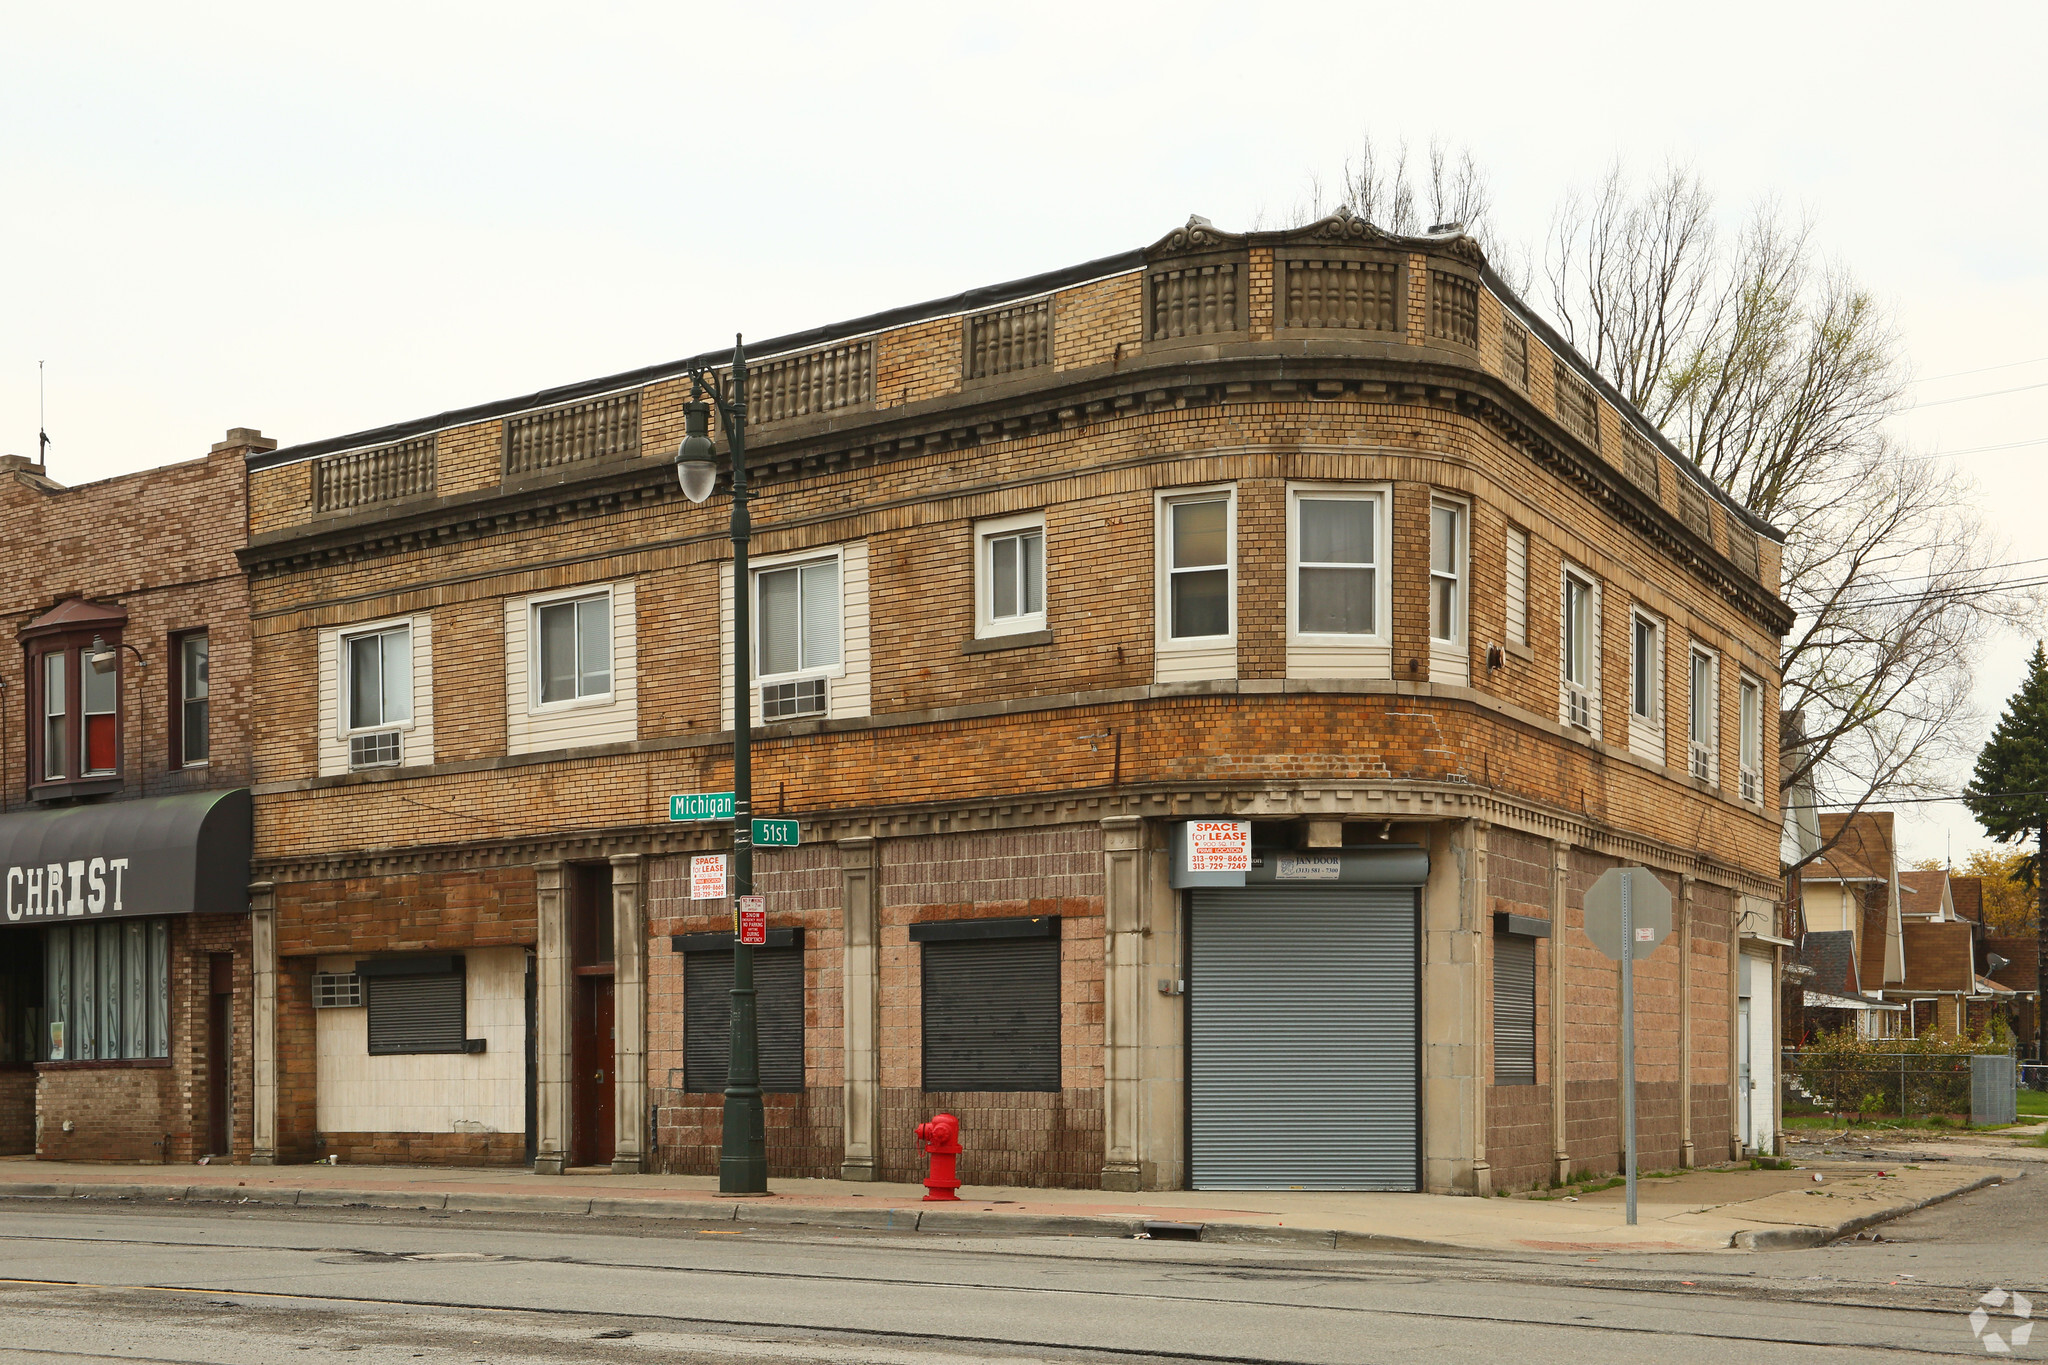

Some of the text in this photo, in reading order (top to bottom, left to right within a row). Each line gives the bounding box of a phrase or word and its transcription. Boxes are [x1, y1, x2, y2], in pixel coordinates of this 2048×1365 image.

[675, 795, 731, 818] Michigan
[1196, 823, 1238, 832] SPACE
[763, 824, 788, 842] 51st
[1192, 832, 1247, 841] for LEASE
[695, 857, 719, 865] SPACE
[1296, 856, 1339, 865] JAN DOOR
[1192, 862, 1247, 870] 313-729-7249
[7, 857, 128, 921] CHRIST
